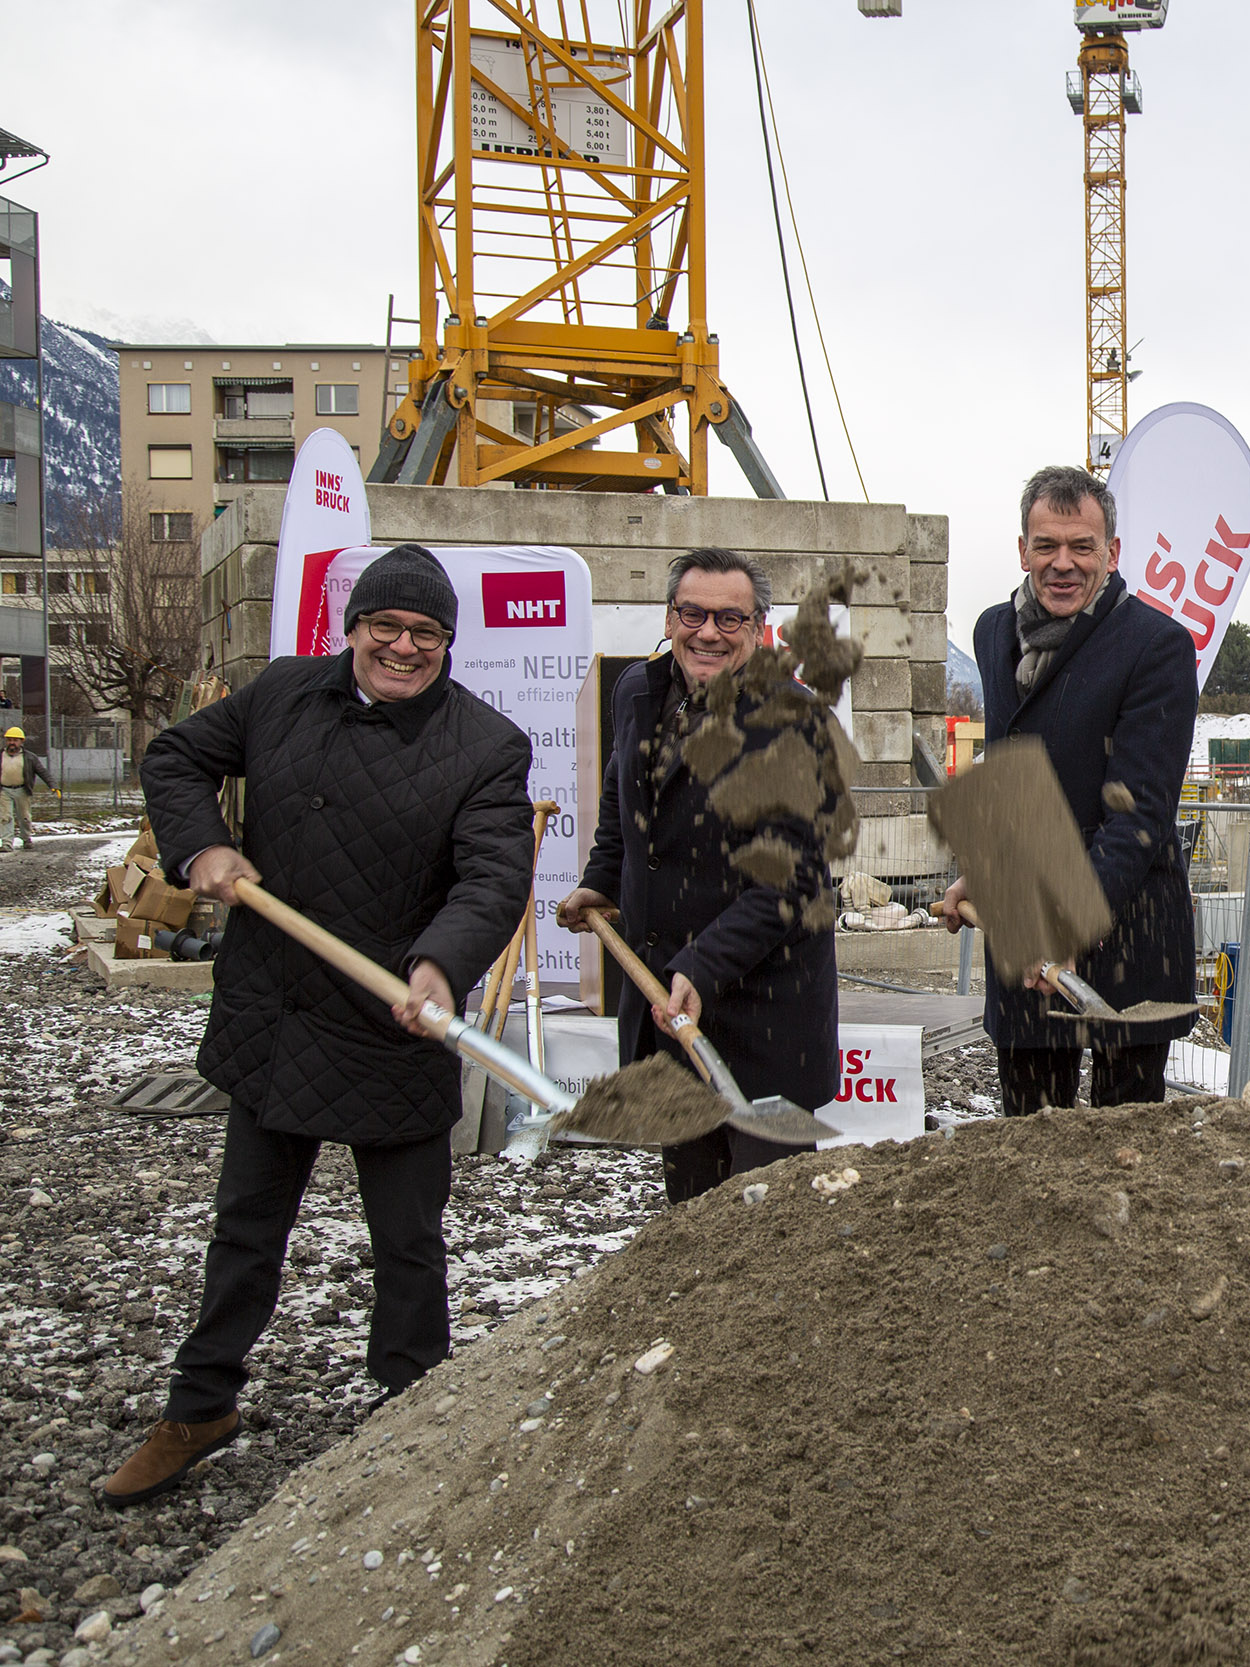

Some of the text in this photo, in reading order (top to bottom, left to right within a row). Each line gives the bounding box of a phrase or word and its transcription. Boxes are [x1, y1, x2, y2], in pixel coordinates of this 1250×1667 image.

[1100, 442, 1111, 459] 4
[315, 470, 343, 492] INNS'
[315, 488, 350, 513] BRUCK
[507, 600, 560, 619] NHT
[464, 659, 516, 670] zeitgemäß
[524, 656, 588, 680] NEUE
